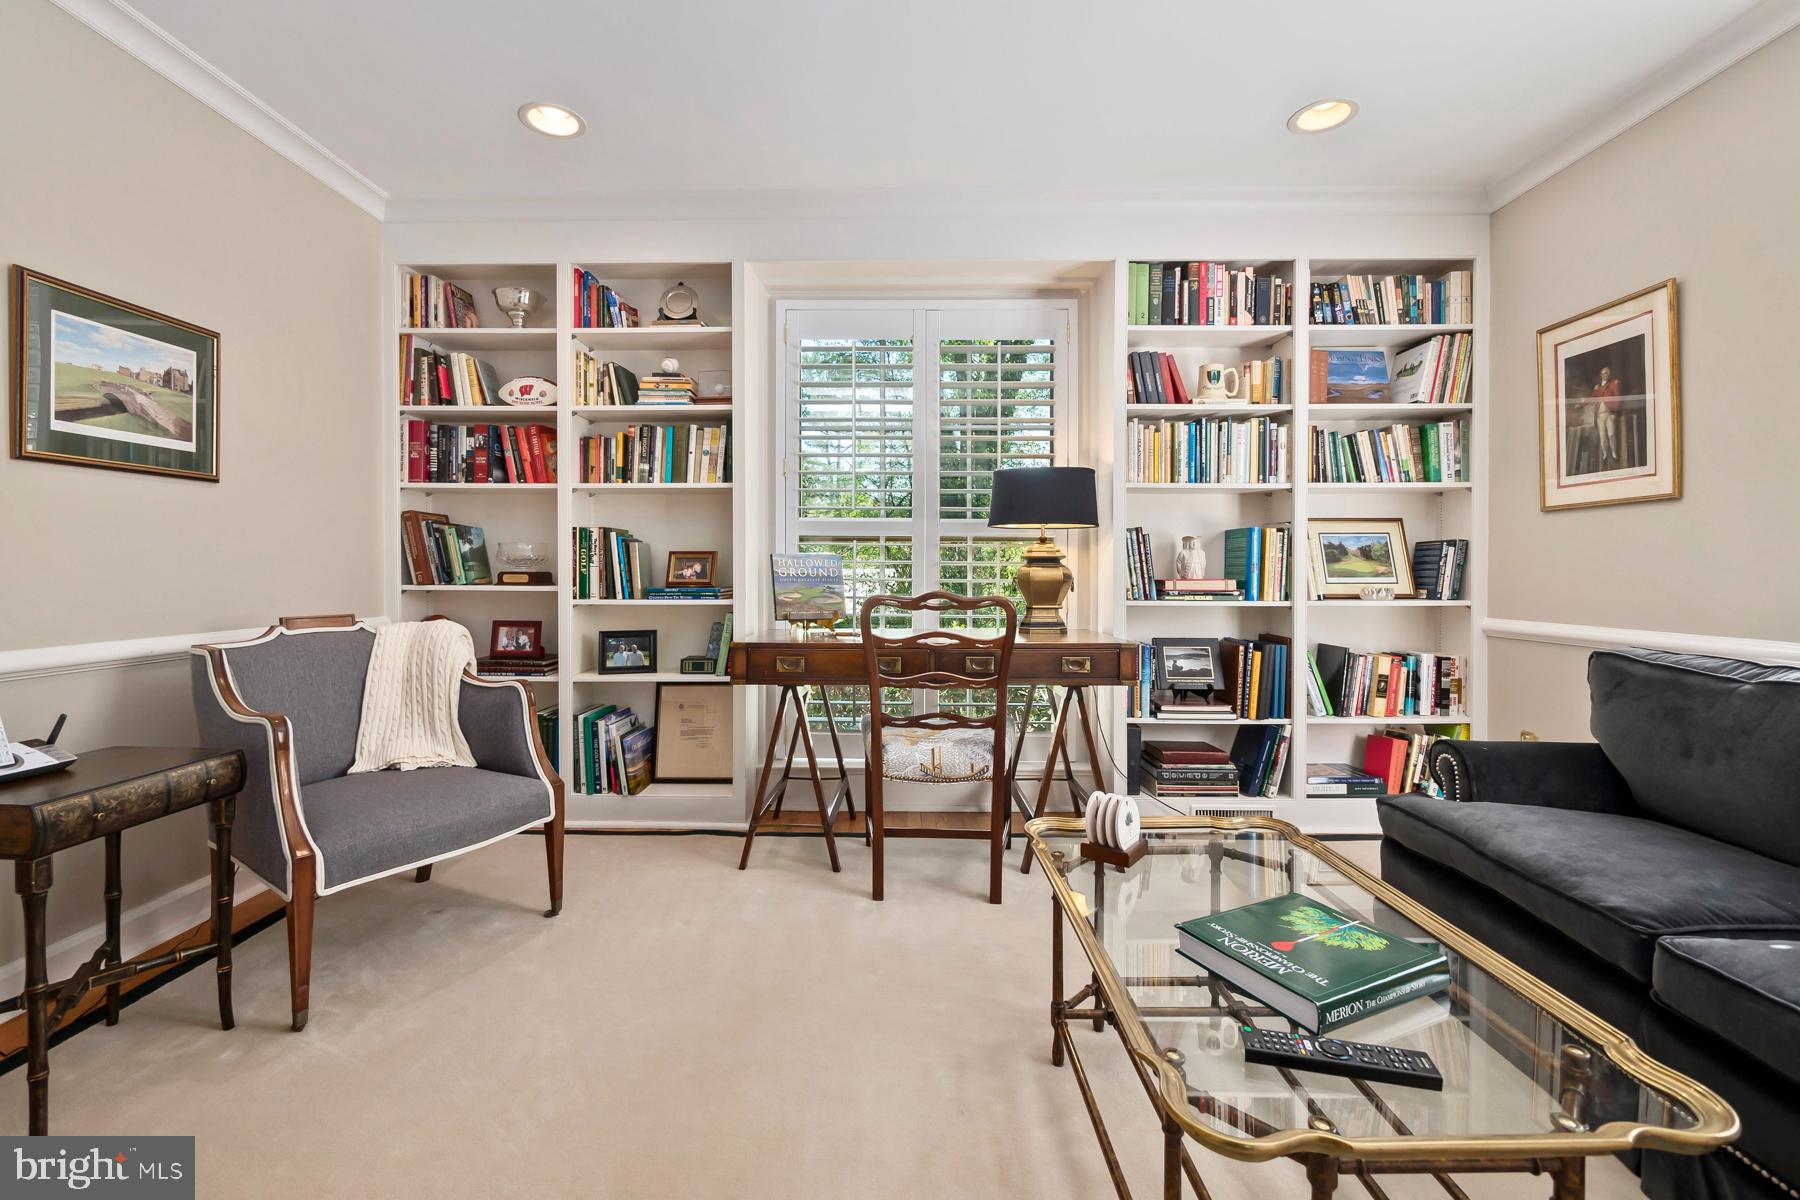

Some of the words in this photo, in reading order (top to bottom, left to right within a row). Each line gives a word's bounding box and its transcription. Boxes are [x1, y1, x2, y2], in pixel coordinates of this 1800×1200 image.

[778, 559, 838, 567] HALLOWED
[778, 567, 838, 577] GROUND
[1216, 937, 1293, 975] MERION
[1304, 972, 1329, 987] THE
[1325, 999, 1364, 1025] MERION
